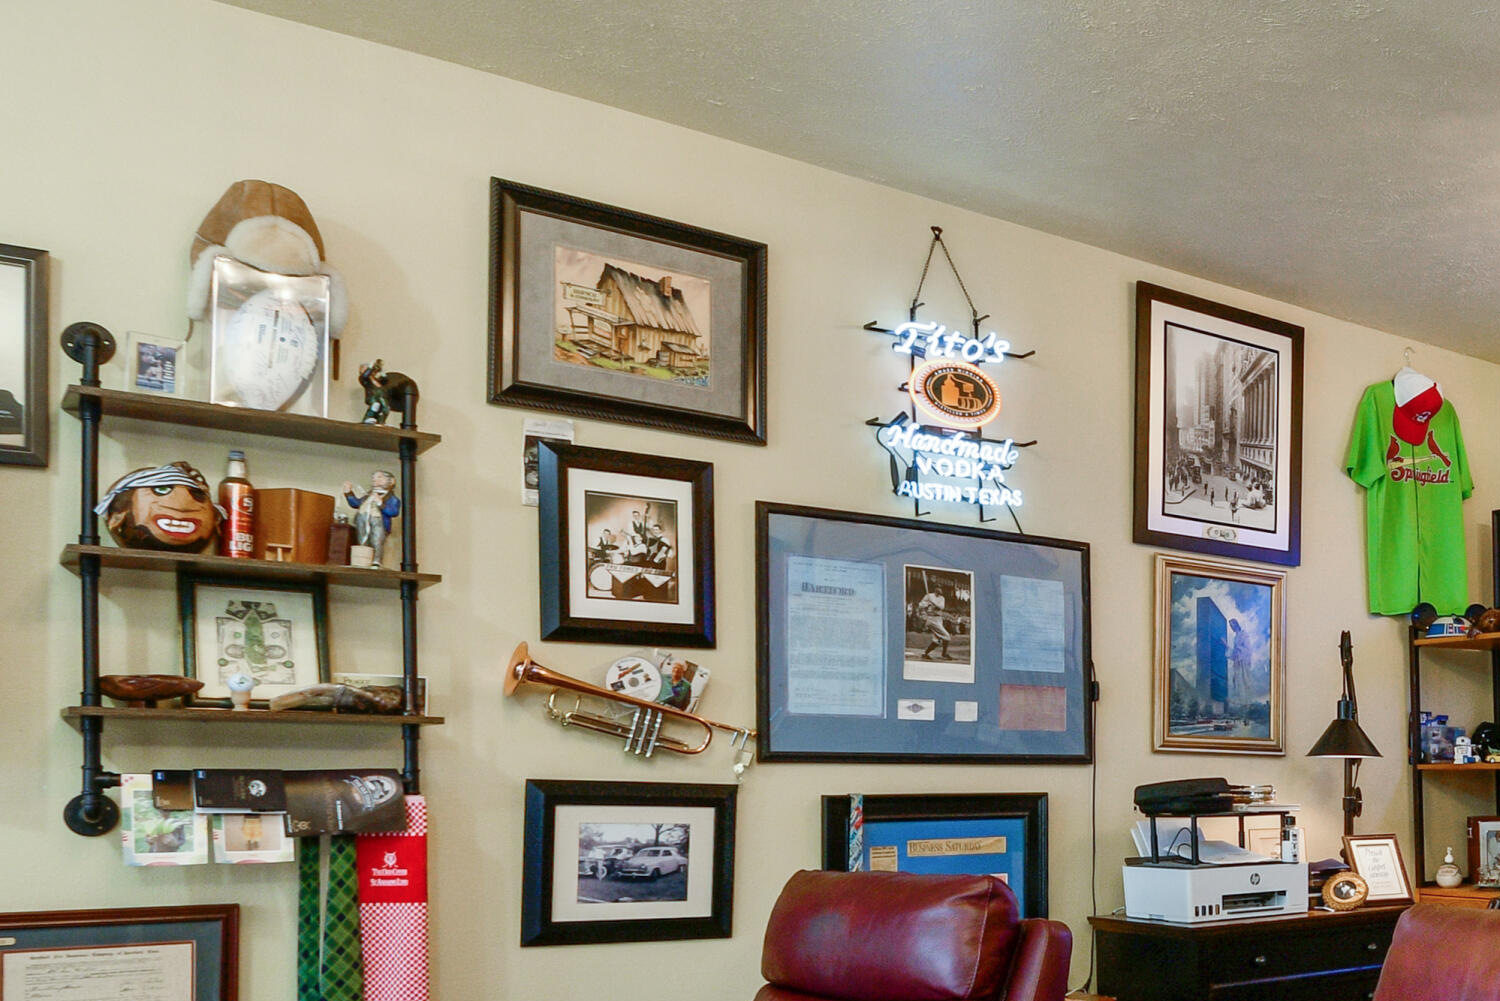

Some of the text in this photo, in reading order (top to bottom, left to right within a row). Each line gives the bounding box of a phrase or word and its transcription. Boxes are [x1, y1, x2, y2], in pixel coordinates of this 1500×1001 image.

[894, 321, 1010, 363] Tito's
[887, 422, 1020, 465] Handmade
[915, 455, 1005, 483] VODKA
[897, 480, 1023, 506] AUSTIN TEXAS
[229, 540, 254, 552] LIG
[235, 532, 254, 543] BU
